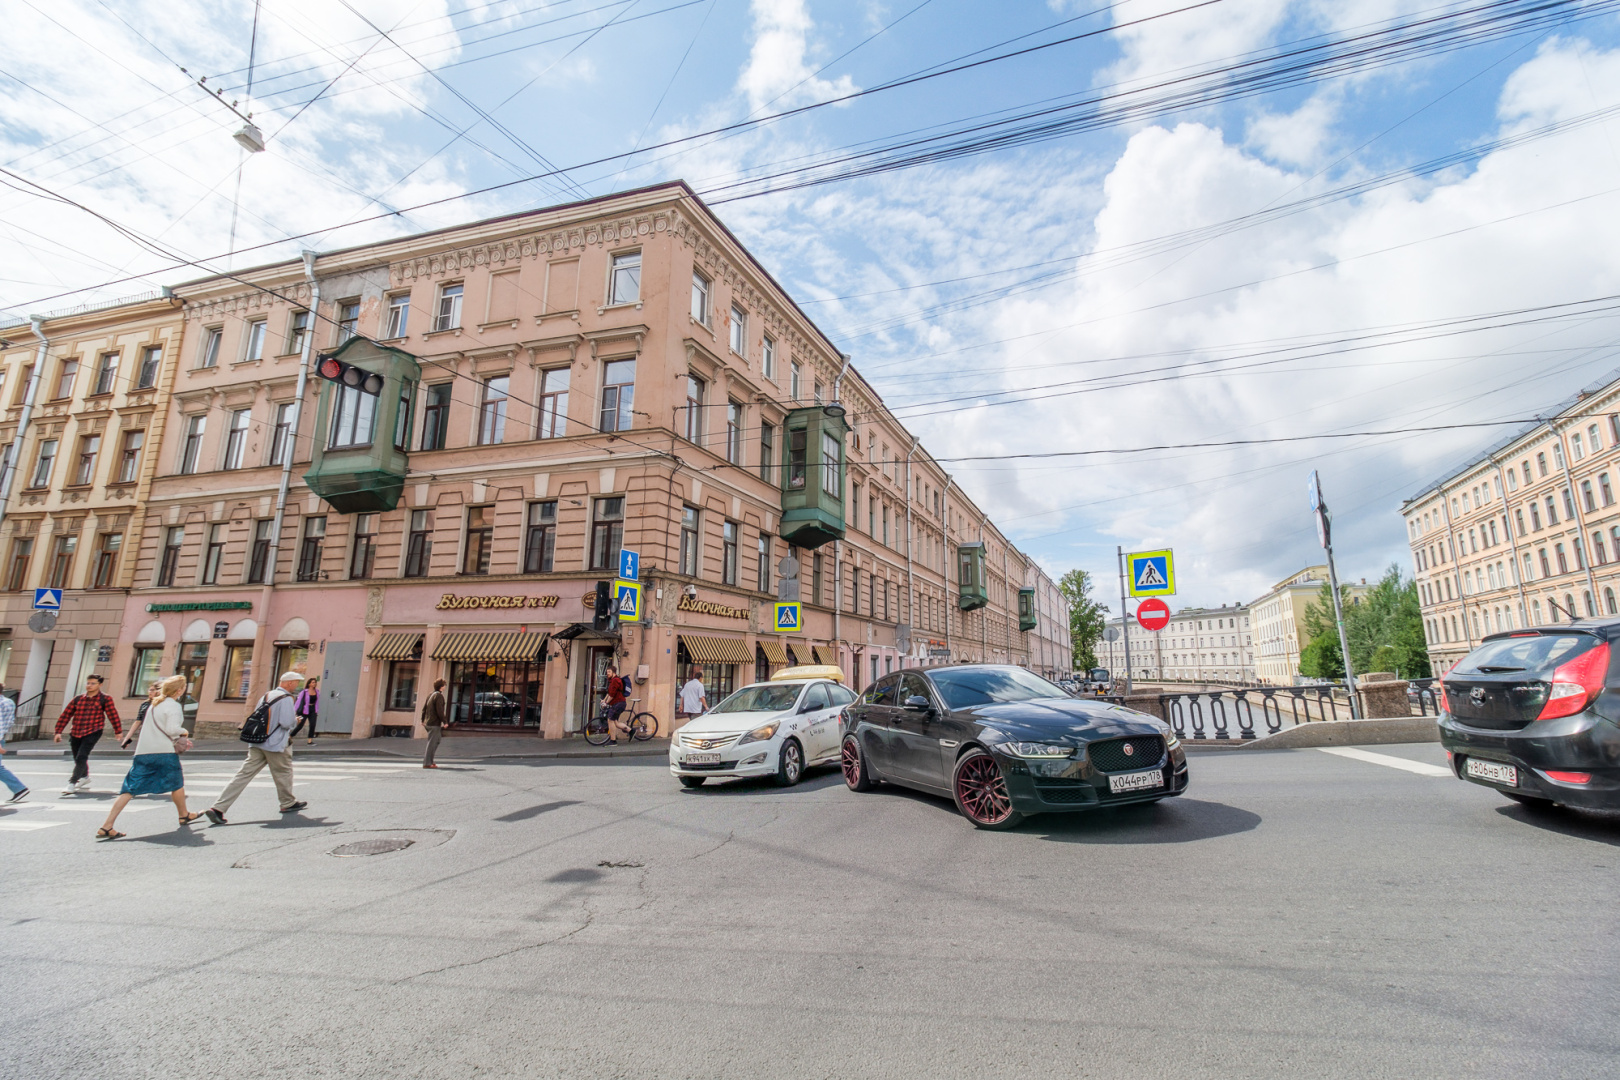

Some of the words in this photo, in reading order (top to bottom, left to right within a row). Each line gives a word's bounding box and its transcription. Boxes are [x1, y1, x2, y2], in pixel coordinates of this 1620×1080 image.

[436, 593, 526, 609] Булочная
[678, 594, 735, 617] Булочная
[1112, 775, 1147, 788] Х044РР
[1149, 770, 1161, 781] 178
[1500, 765, 1514, 778] 178
